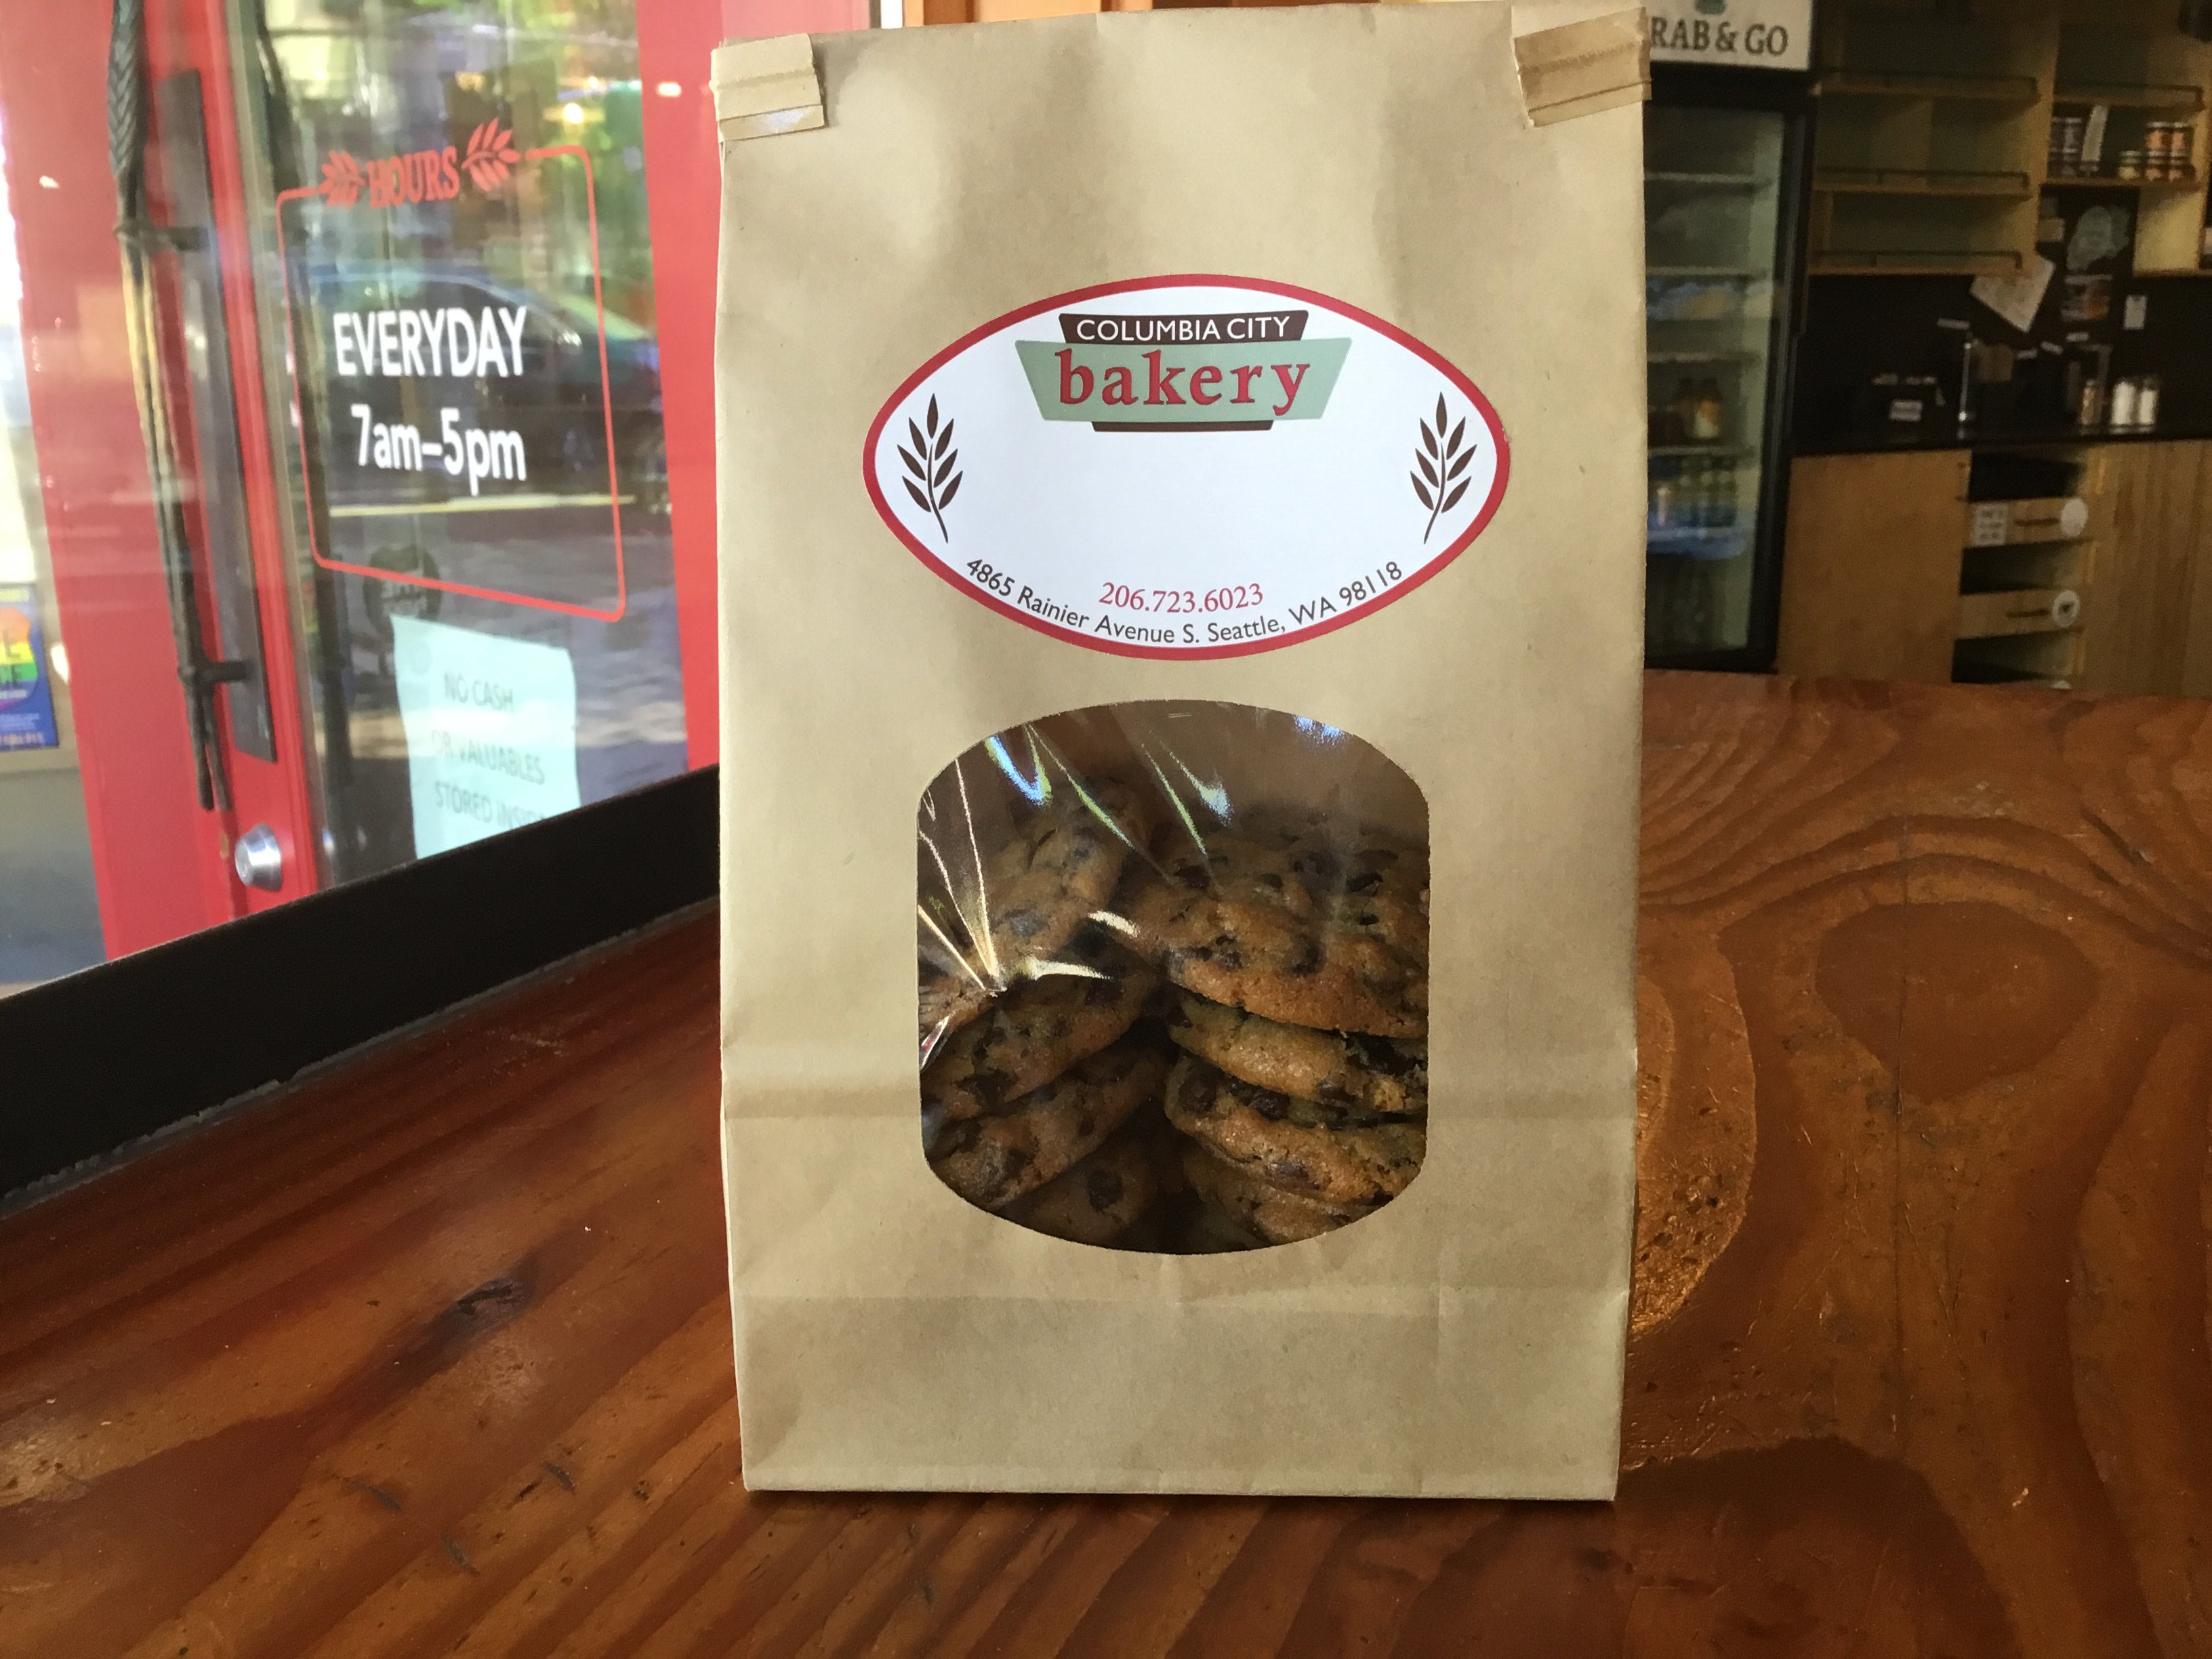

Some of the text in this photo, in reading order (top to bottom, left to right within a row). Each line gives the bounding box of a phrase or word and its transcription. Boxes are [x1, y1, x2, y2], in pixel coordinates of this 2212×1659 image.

[1650, 16, 1711, 52] RAB
[367, 145, 460, 208] HOURS
[333, 306, 527, 378] EVERYDAY
[1076, 316, 1290, 342] COLUMBIA CITY
[1054, 348, 1311, 416] bakery
[966, 558, 1402, 644] 4865 Rainier Avenue S. Seattle, WA 98118
[1099, 581, 1264, 614] 206.723.6023
[444, 671, 514, 714] NO CASH
[459, 739, 546, 785] VALUABLES
[435, 779, 493, 823] STORED
